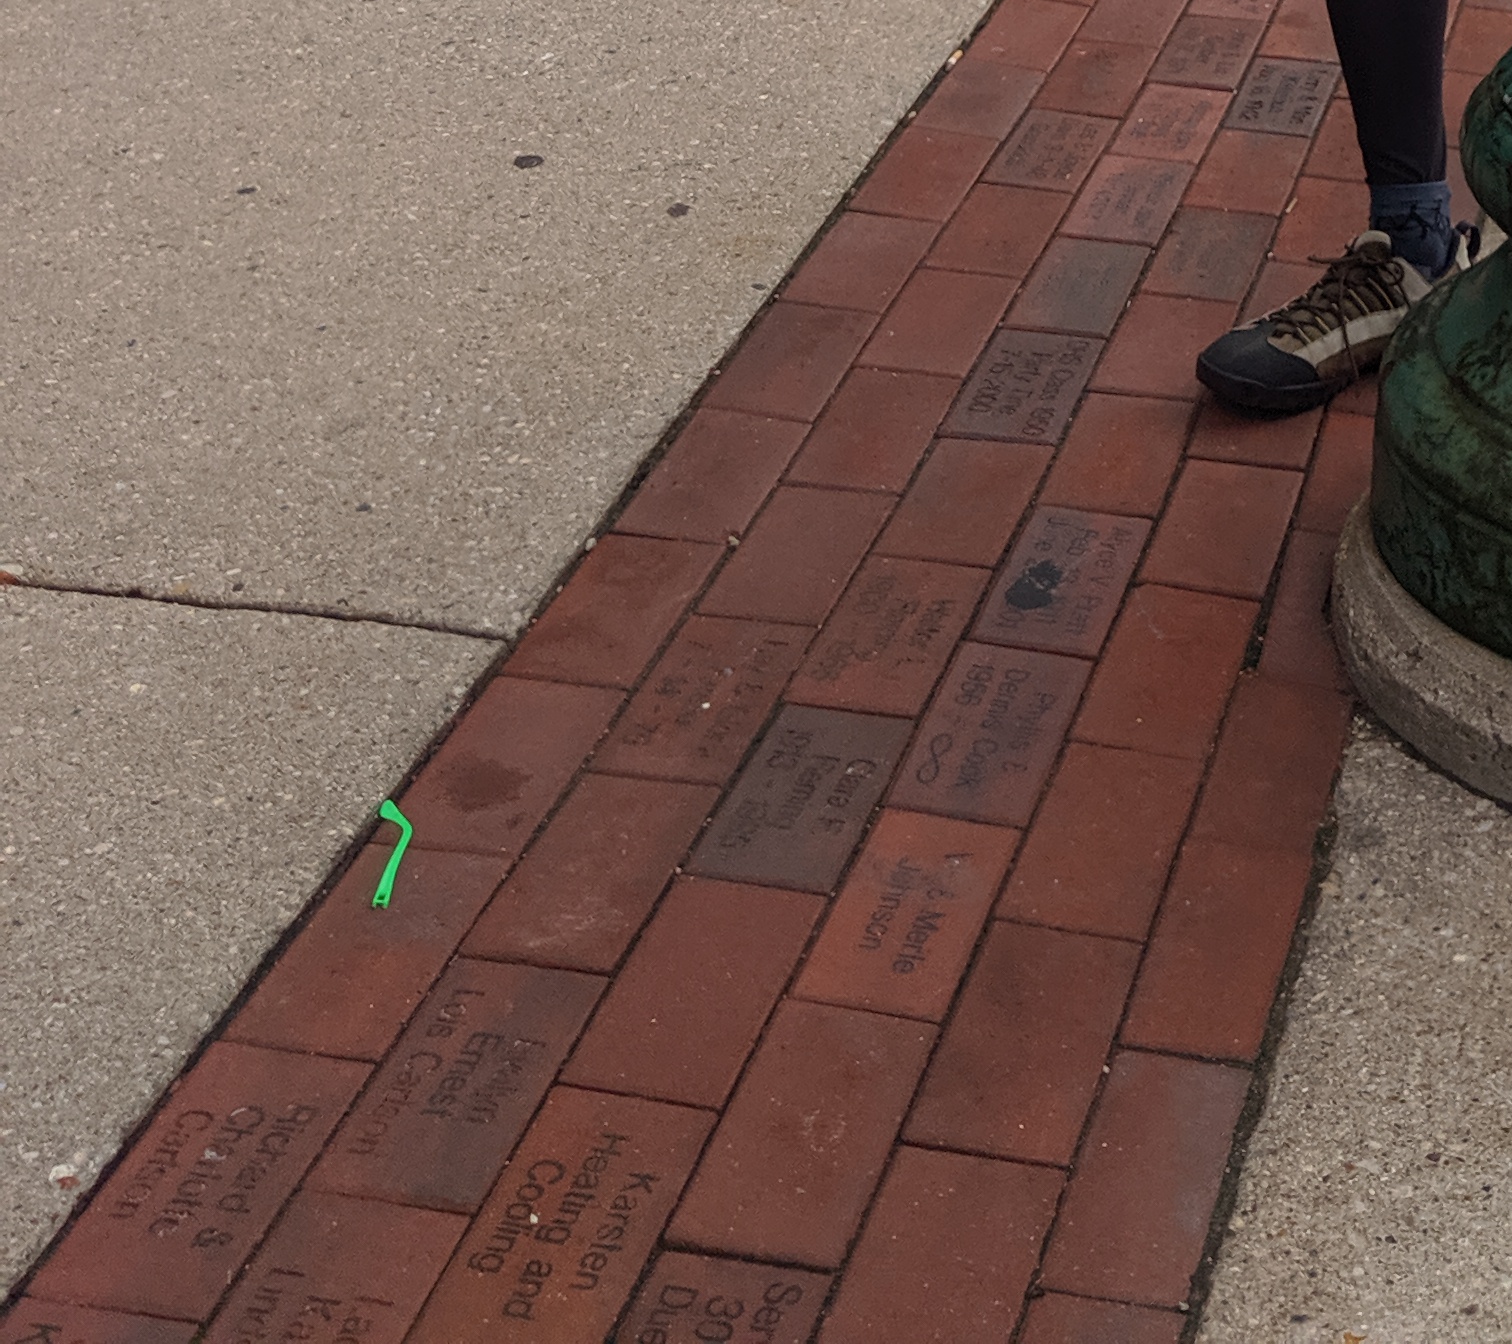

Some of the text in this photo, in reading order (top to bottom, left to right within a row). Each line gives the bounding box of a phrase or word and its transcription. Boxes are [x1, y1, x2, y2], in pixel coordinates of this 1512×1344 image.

[977, 666, 1033, 733] Dennis
[824, 756, 881, 809] Clara
[950, 735, 1001, 792] Cook
[853, 854, 928, 954] Johnson
[887, 908, 947, 977] Merle
[343, 986, 486, 1160] Lois Carlson
[417, 1029, 506, 1121] Ernest
[100, 1107, 219, 1223] Carlson
[138, 1101, 274, 1241] Charlotte
[208, 1100, 323, 1217] Richard
[460, 1155, 571, 1278] Cooling
[496, 1129, 632, 1322] Heating and
[564, 1169, 663, 1294] Karsten
